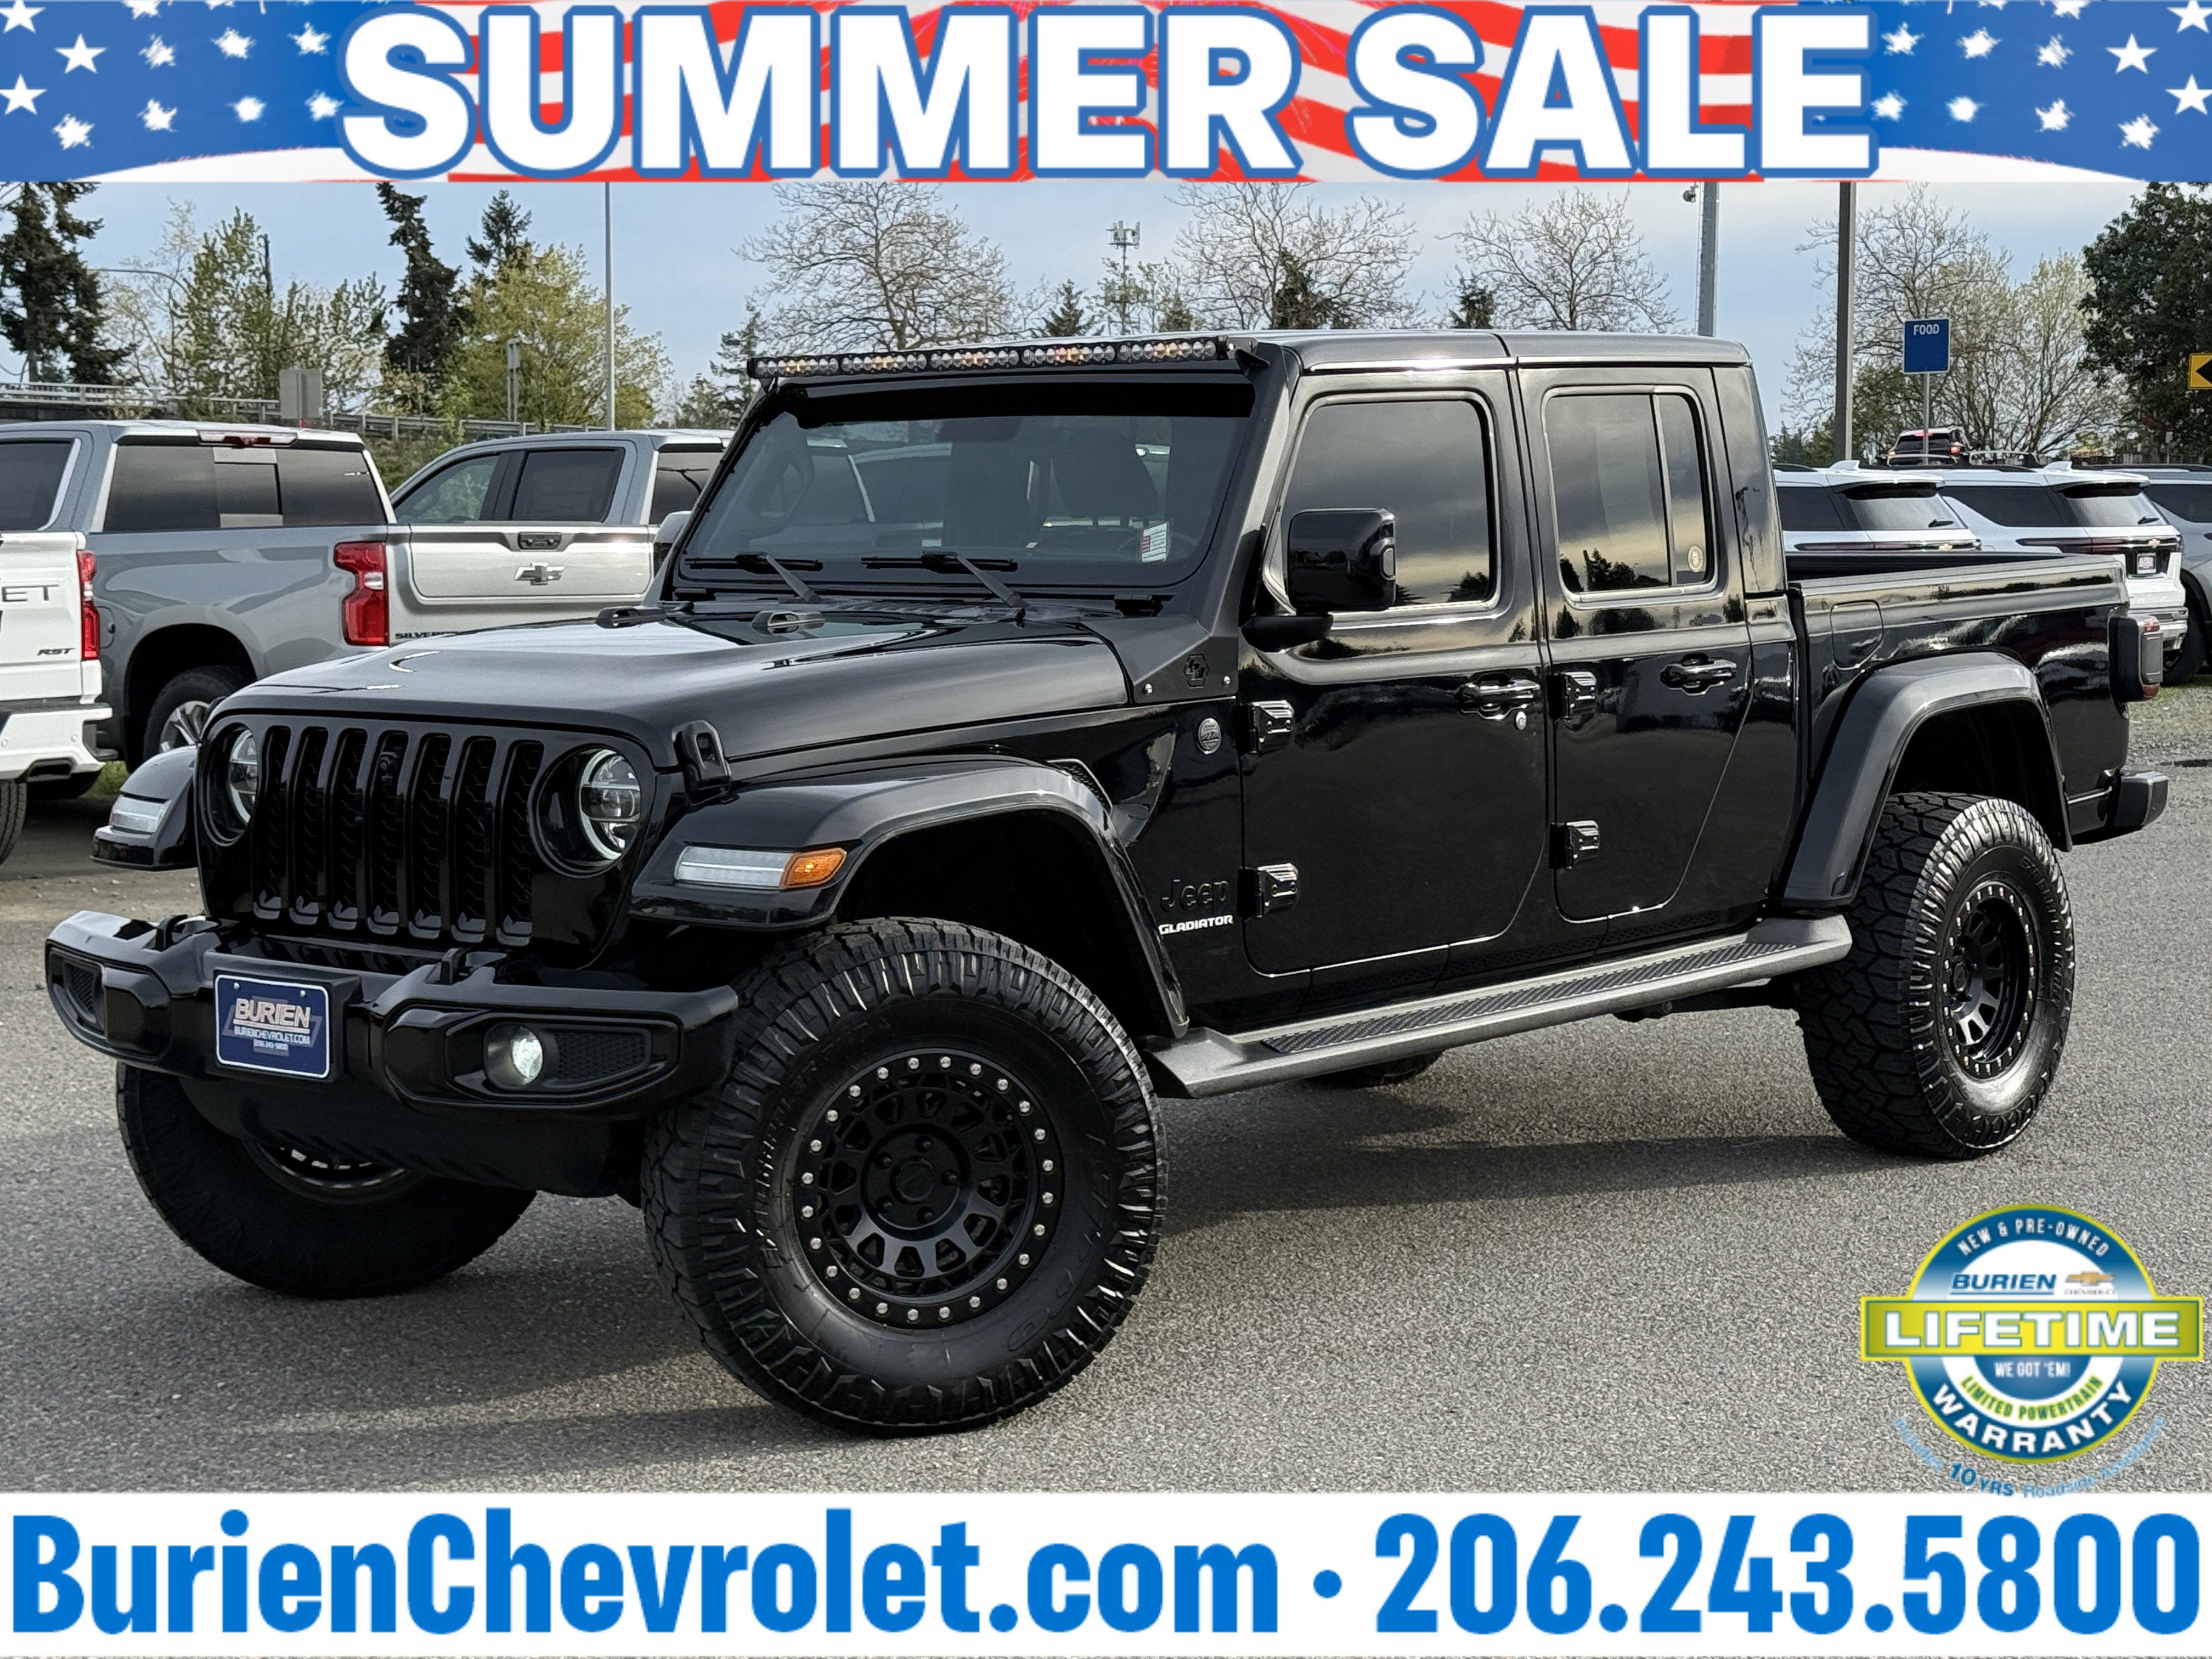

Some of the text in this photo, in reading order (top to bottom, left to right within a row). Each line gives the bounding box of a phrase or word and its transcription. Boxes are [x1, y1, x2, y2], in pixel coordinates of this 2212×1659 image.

[1913, 324, 1940, 336] FOOD
[37, 647, 76, 656] RST
[1160, 879, 1229, 912] Jeep
[1158, 915, 1234, 935] GLADIATOR
[235, 997, 311, 1028] BURIEN
